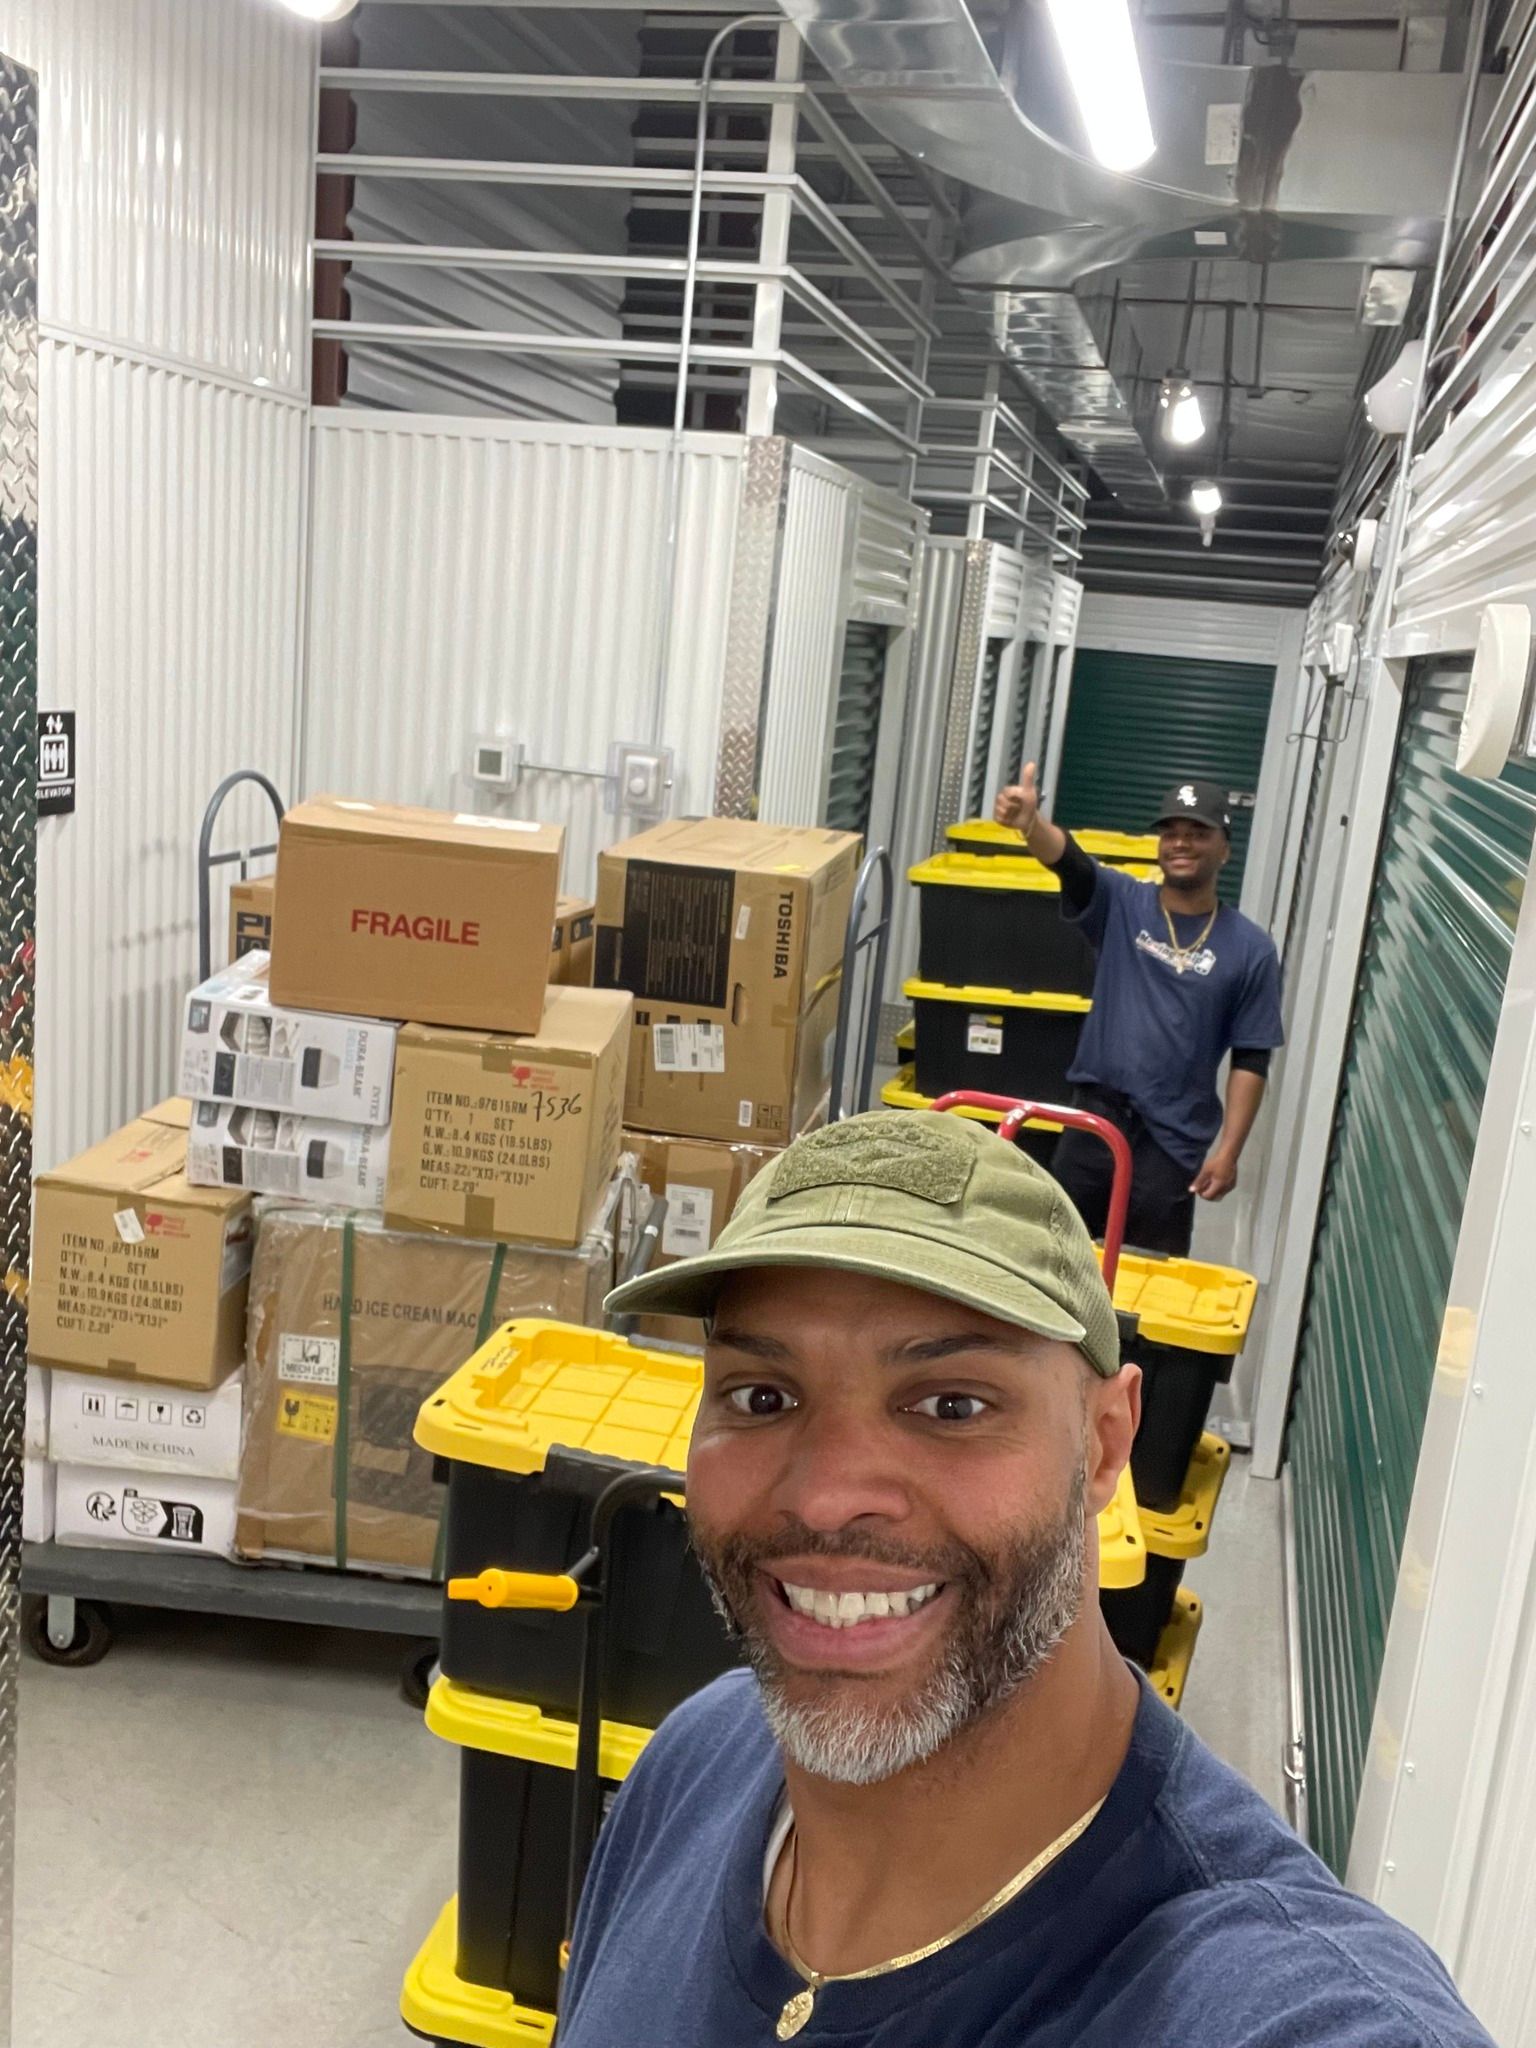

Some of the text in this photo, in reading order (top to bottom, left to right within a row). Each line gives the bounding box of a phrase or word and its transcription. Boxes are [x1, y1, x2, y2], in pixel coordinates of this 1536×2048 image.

[36, 786, 71, 800] ELEVATOR
[351, 909, 481, 946] FRAGILE
[773, 891, 794, 979] TOSHIBA
[370, 1085, 381, 1120] INTEX
[426, 1090, 453, 1106] ITEM
[531, 1091, 582, 1122] 7536
[468, 1112, 474, 1125] 1
[494, 1117, 515, 1132] SET
[475, 1131, 497, 1146] KGS
[62, 1233, 87, 1249] ITEM
[127, 1262, 146, 1276] SET
[109, 1276, 129, 1290] KGS
[323, 1293, 362, 1314] HAD
[366, 1300, 390, 1318] ICE
[312, 1365, 330, 1376] LIFT
[92, 1436, 195, 1457] MADE IN CHINA
